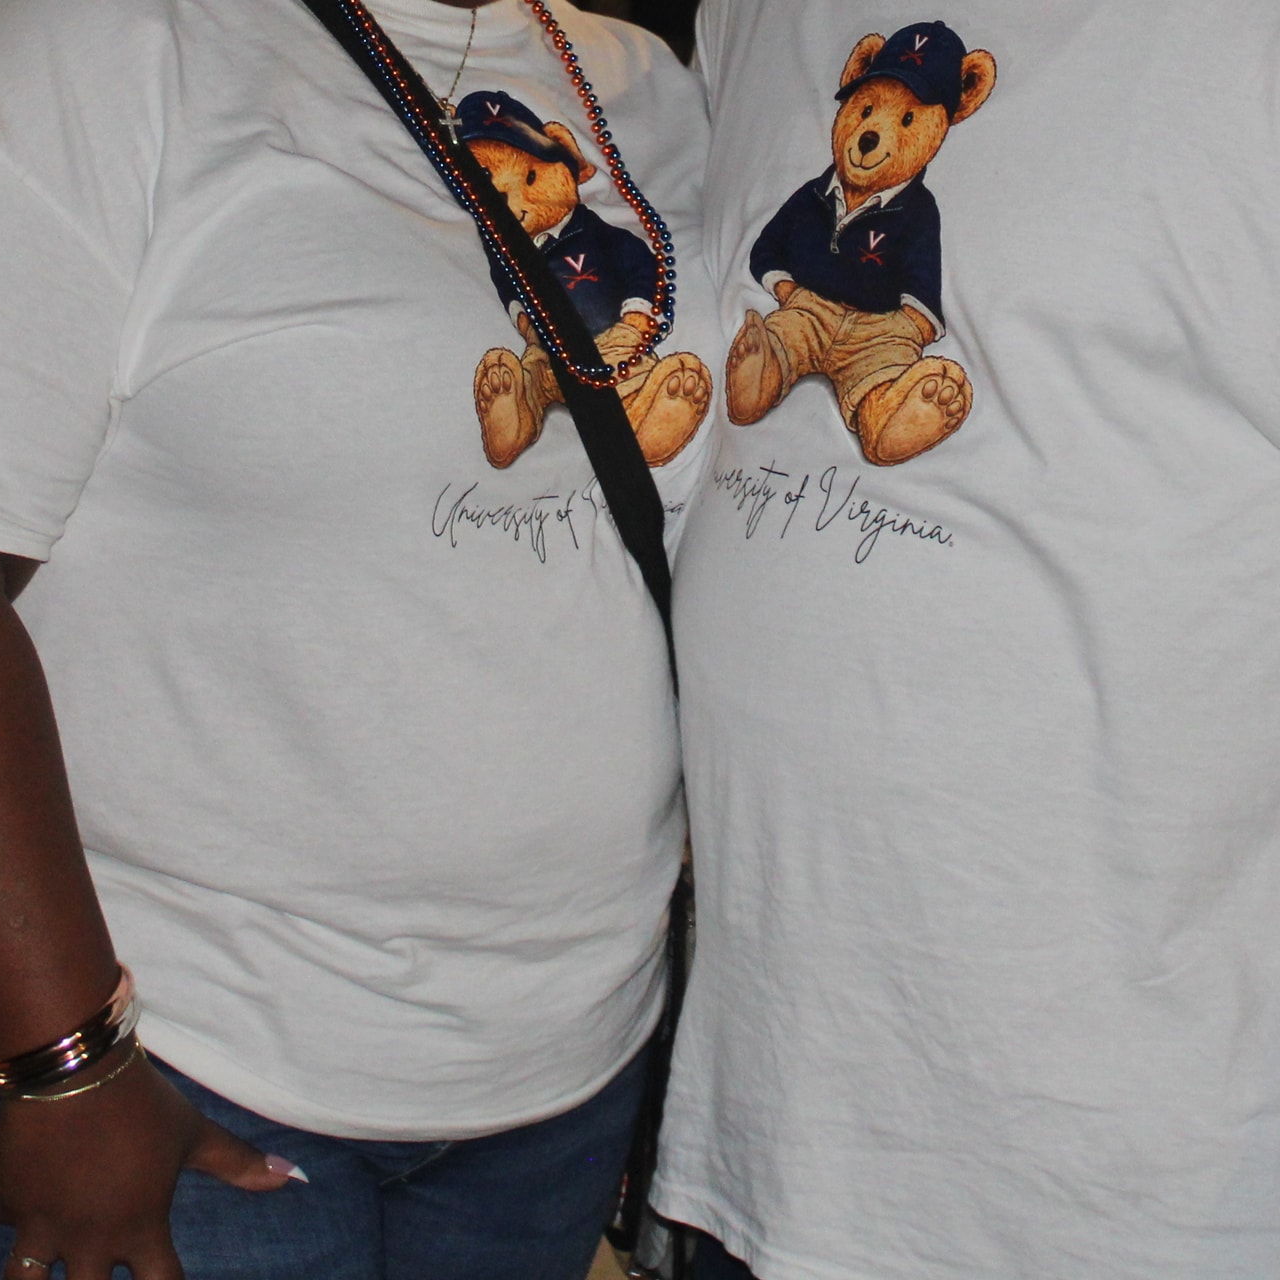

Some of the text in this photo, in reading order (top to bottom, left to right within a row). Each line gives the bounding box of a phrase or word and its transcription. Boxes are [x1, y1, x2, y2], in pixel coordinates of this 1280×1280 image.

[431, 481, 560, 564] University
[556, 489, 580, 550] of
[783, 474, 810, 539] of
